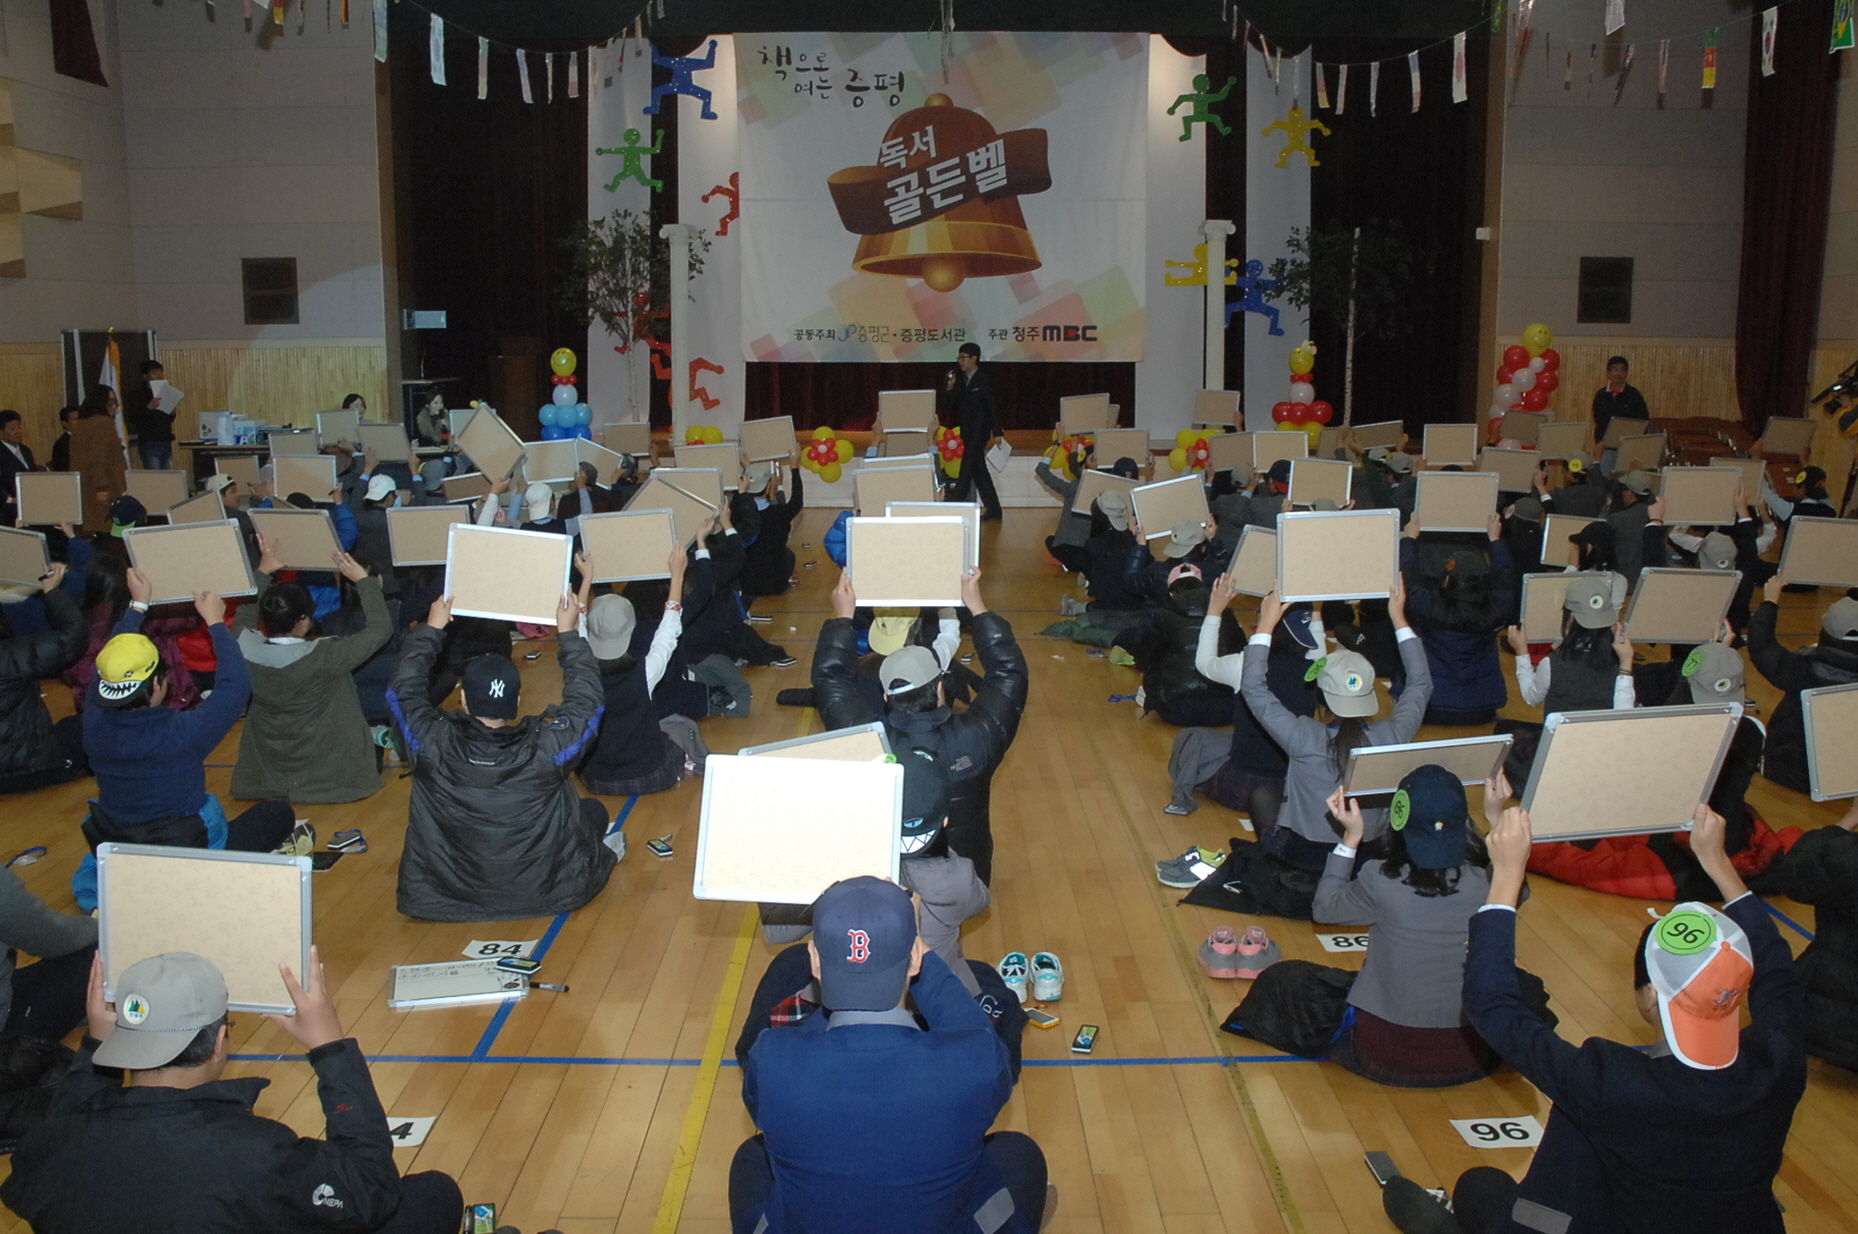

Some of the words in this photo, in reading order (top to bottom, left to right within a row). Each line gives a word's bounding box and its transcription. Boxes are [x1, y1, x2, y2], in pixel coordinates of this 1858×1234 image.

[758, 46, 829, 81] 책으로
[794, 76, 832, 99] 여는
[845, 68, 904, 107] 증평
[880, 125, 937, 169] 독서
[884, 138, 1008, 225] 골든벨
[794, 329, 836, 341] 공동주최
[900, 328, 966, 343] 증평도서관
[988, 328, 1008, 341] 주관
[1332, 935, 1369, 948] 86
[1667, 922, 1705, 944] 96
[478, 943, 522, 956] 84
[846, 928, 871, 964] B
[1469, 1121, 1530, 1142] 96
